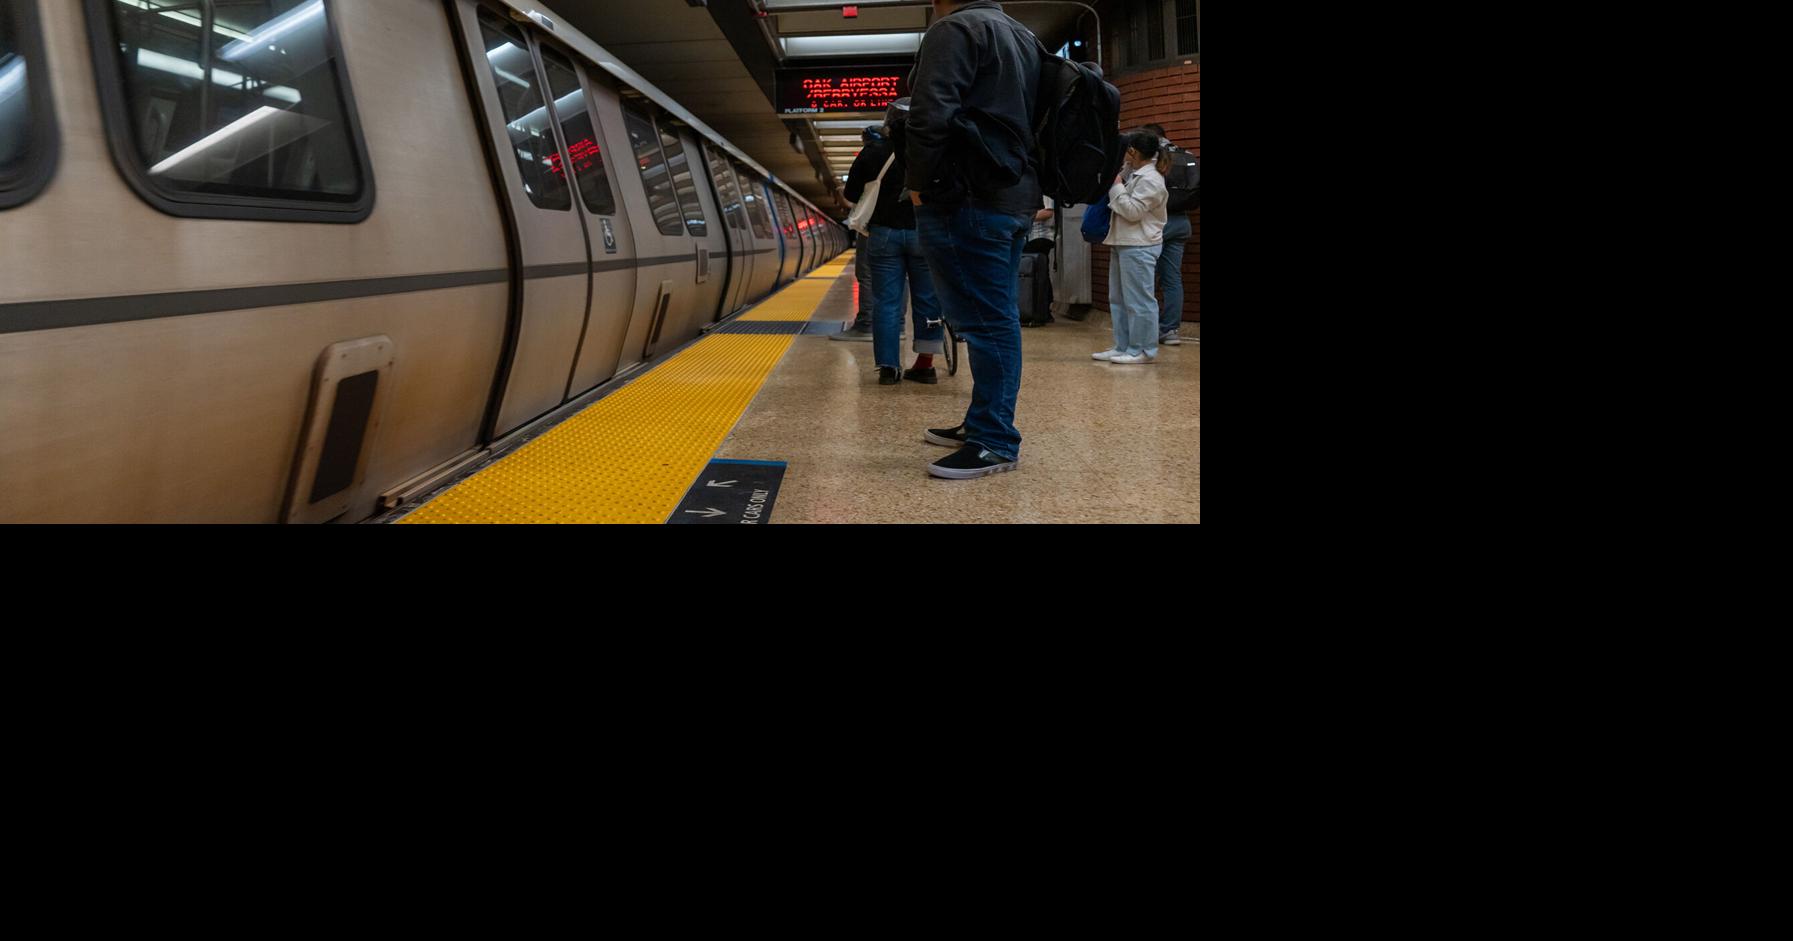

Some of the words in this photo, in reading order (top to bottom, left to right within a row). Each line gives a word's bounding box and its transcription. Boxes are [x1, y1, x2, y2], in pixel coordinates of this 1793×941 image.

[803, 78, 832, 89] OAK
[840, 76, 900, 88] AIRPORT
[749, 488, 769, 503] ONLY
[743, 503, 764, 519] CARS
